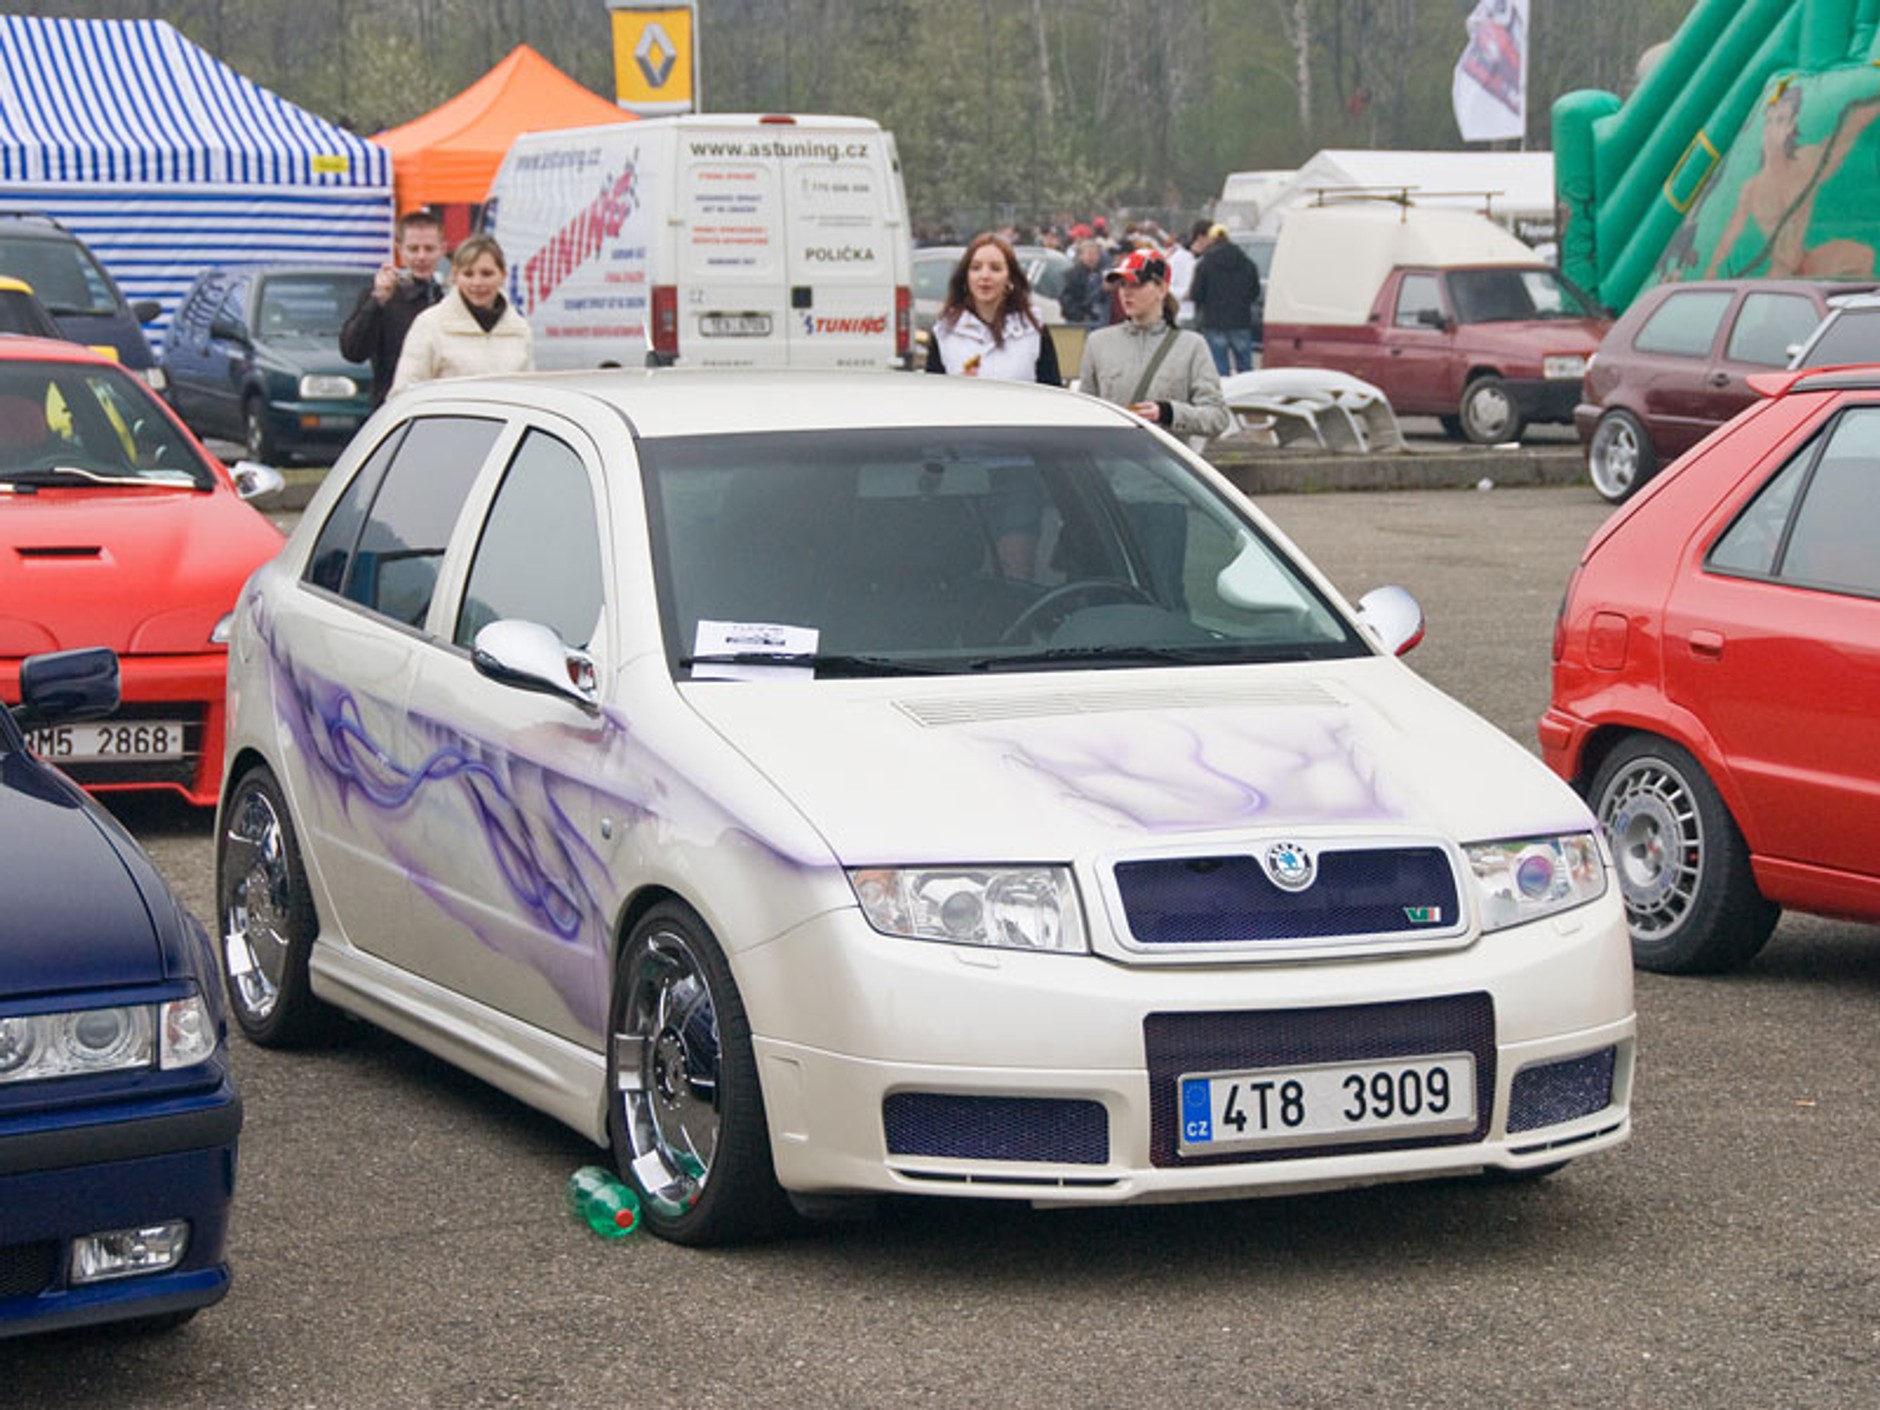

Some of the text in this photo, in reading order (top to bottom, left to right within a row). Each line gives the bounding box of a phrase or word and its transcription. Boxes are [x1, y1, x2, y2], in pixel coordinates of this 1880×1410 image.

[690, 141, 868, 161] www.astuning.cz
[805, 245, 875, 262] POLIČKA
[97, 726, 168, 754] 2868
[1222, 1066, 1451, 1132] 4T8 3909
[1186, 1121, 1209, 1137] CZ
